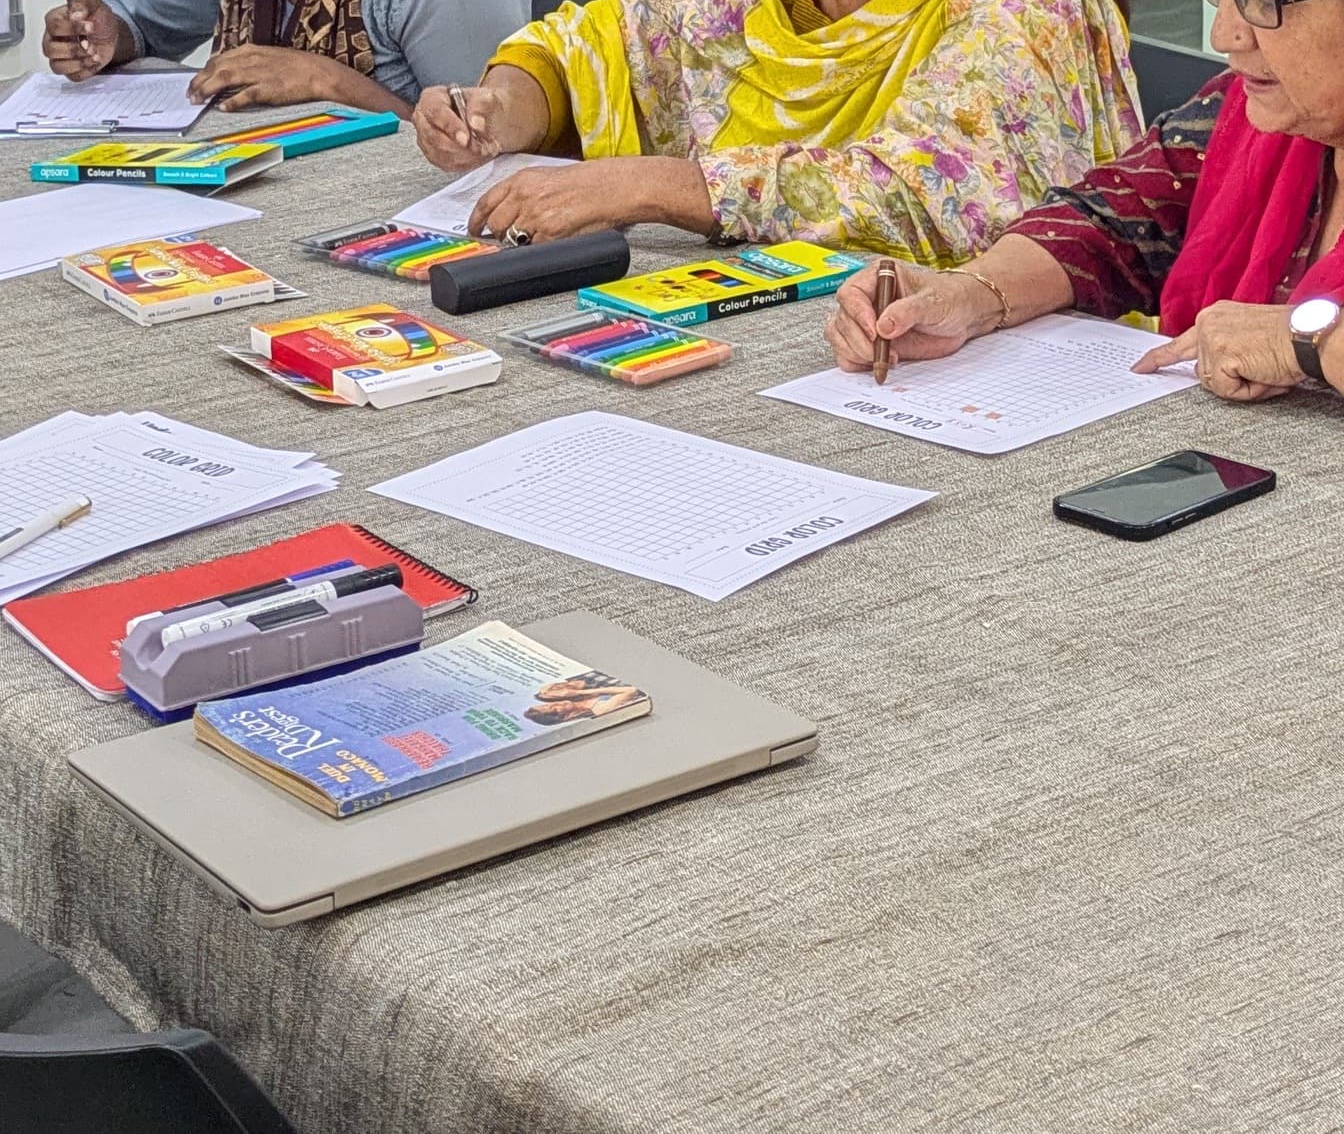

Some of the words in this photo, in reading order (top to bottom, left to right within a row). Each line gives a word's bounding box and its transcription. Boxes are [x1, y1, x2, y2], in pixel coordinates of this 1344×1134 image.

[40, 168, 69, 179] apsara
[87, 168, 114, 177] Colour
[116, 168, 146, 178] Pencils
[748, 253, 802, 274] apsara
[718, 299, 750, 313] Colour
[752, 290, 787, 307] Pencils
[662, 311, 697, 326] apsara
[844, 400, 889, 415] GRID
[883, 412, 942, 430] COLOR
[142, 447, 199, 467] COLOR
[189, 462, 236, 477] GRID
[782, 516, 845, 540] COLOR
[744, 536, 793, 556] GRID
[258, 705, 301, 736] Digest
[232, 709, 344, 760] Reader's
[317, 762, 352, 783] DUEL
[336, 749, 391, 783] MONACO
[338, 763, 358, 773] IN
